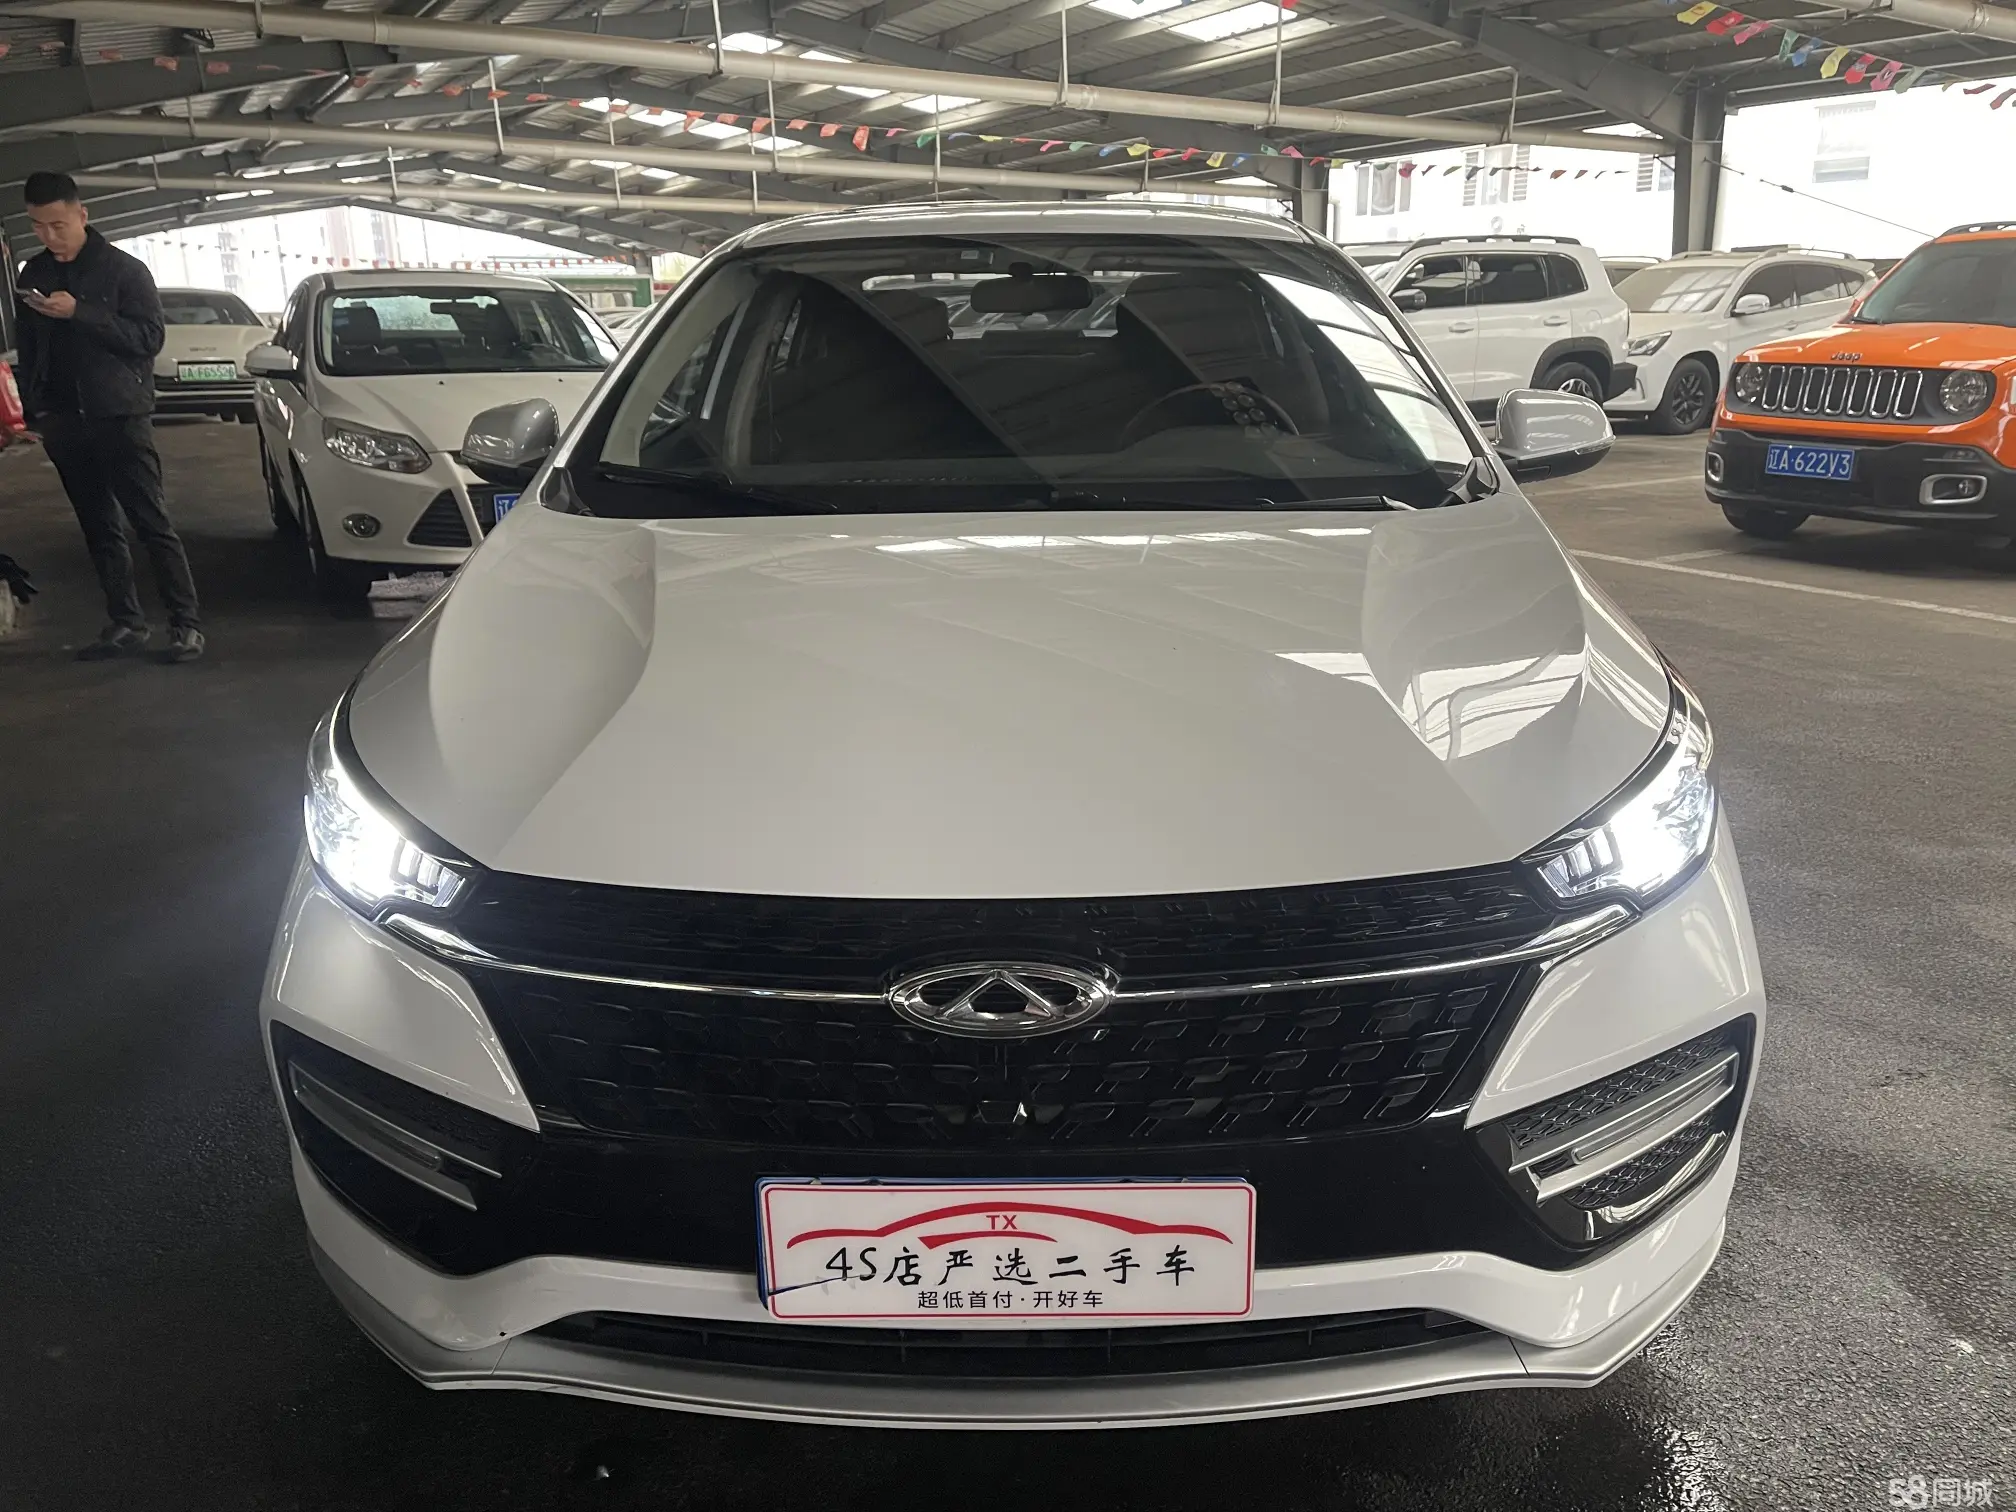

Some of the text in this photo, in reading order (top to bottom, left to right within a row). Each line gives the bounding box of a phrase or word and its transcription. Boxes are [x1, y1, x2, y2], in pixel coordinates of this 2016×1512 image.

[1830, 351, 1863, 362] Jeep
[986, 1215, 1018, 1230] TX
[825, 1244, 1195, 1287] 4S店严选二手车
[917, 1290, 1104, 1309] 超低首付·开好车
